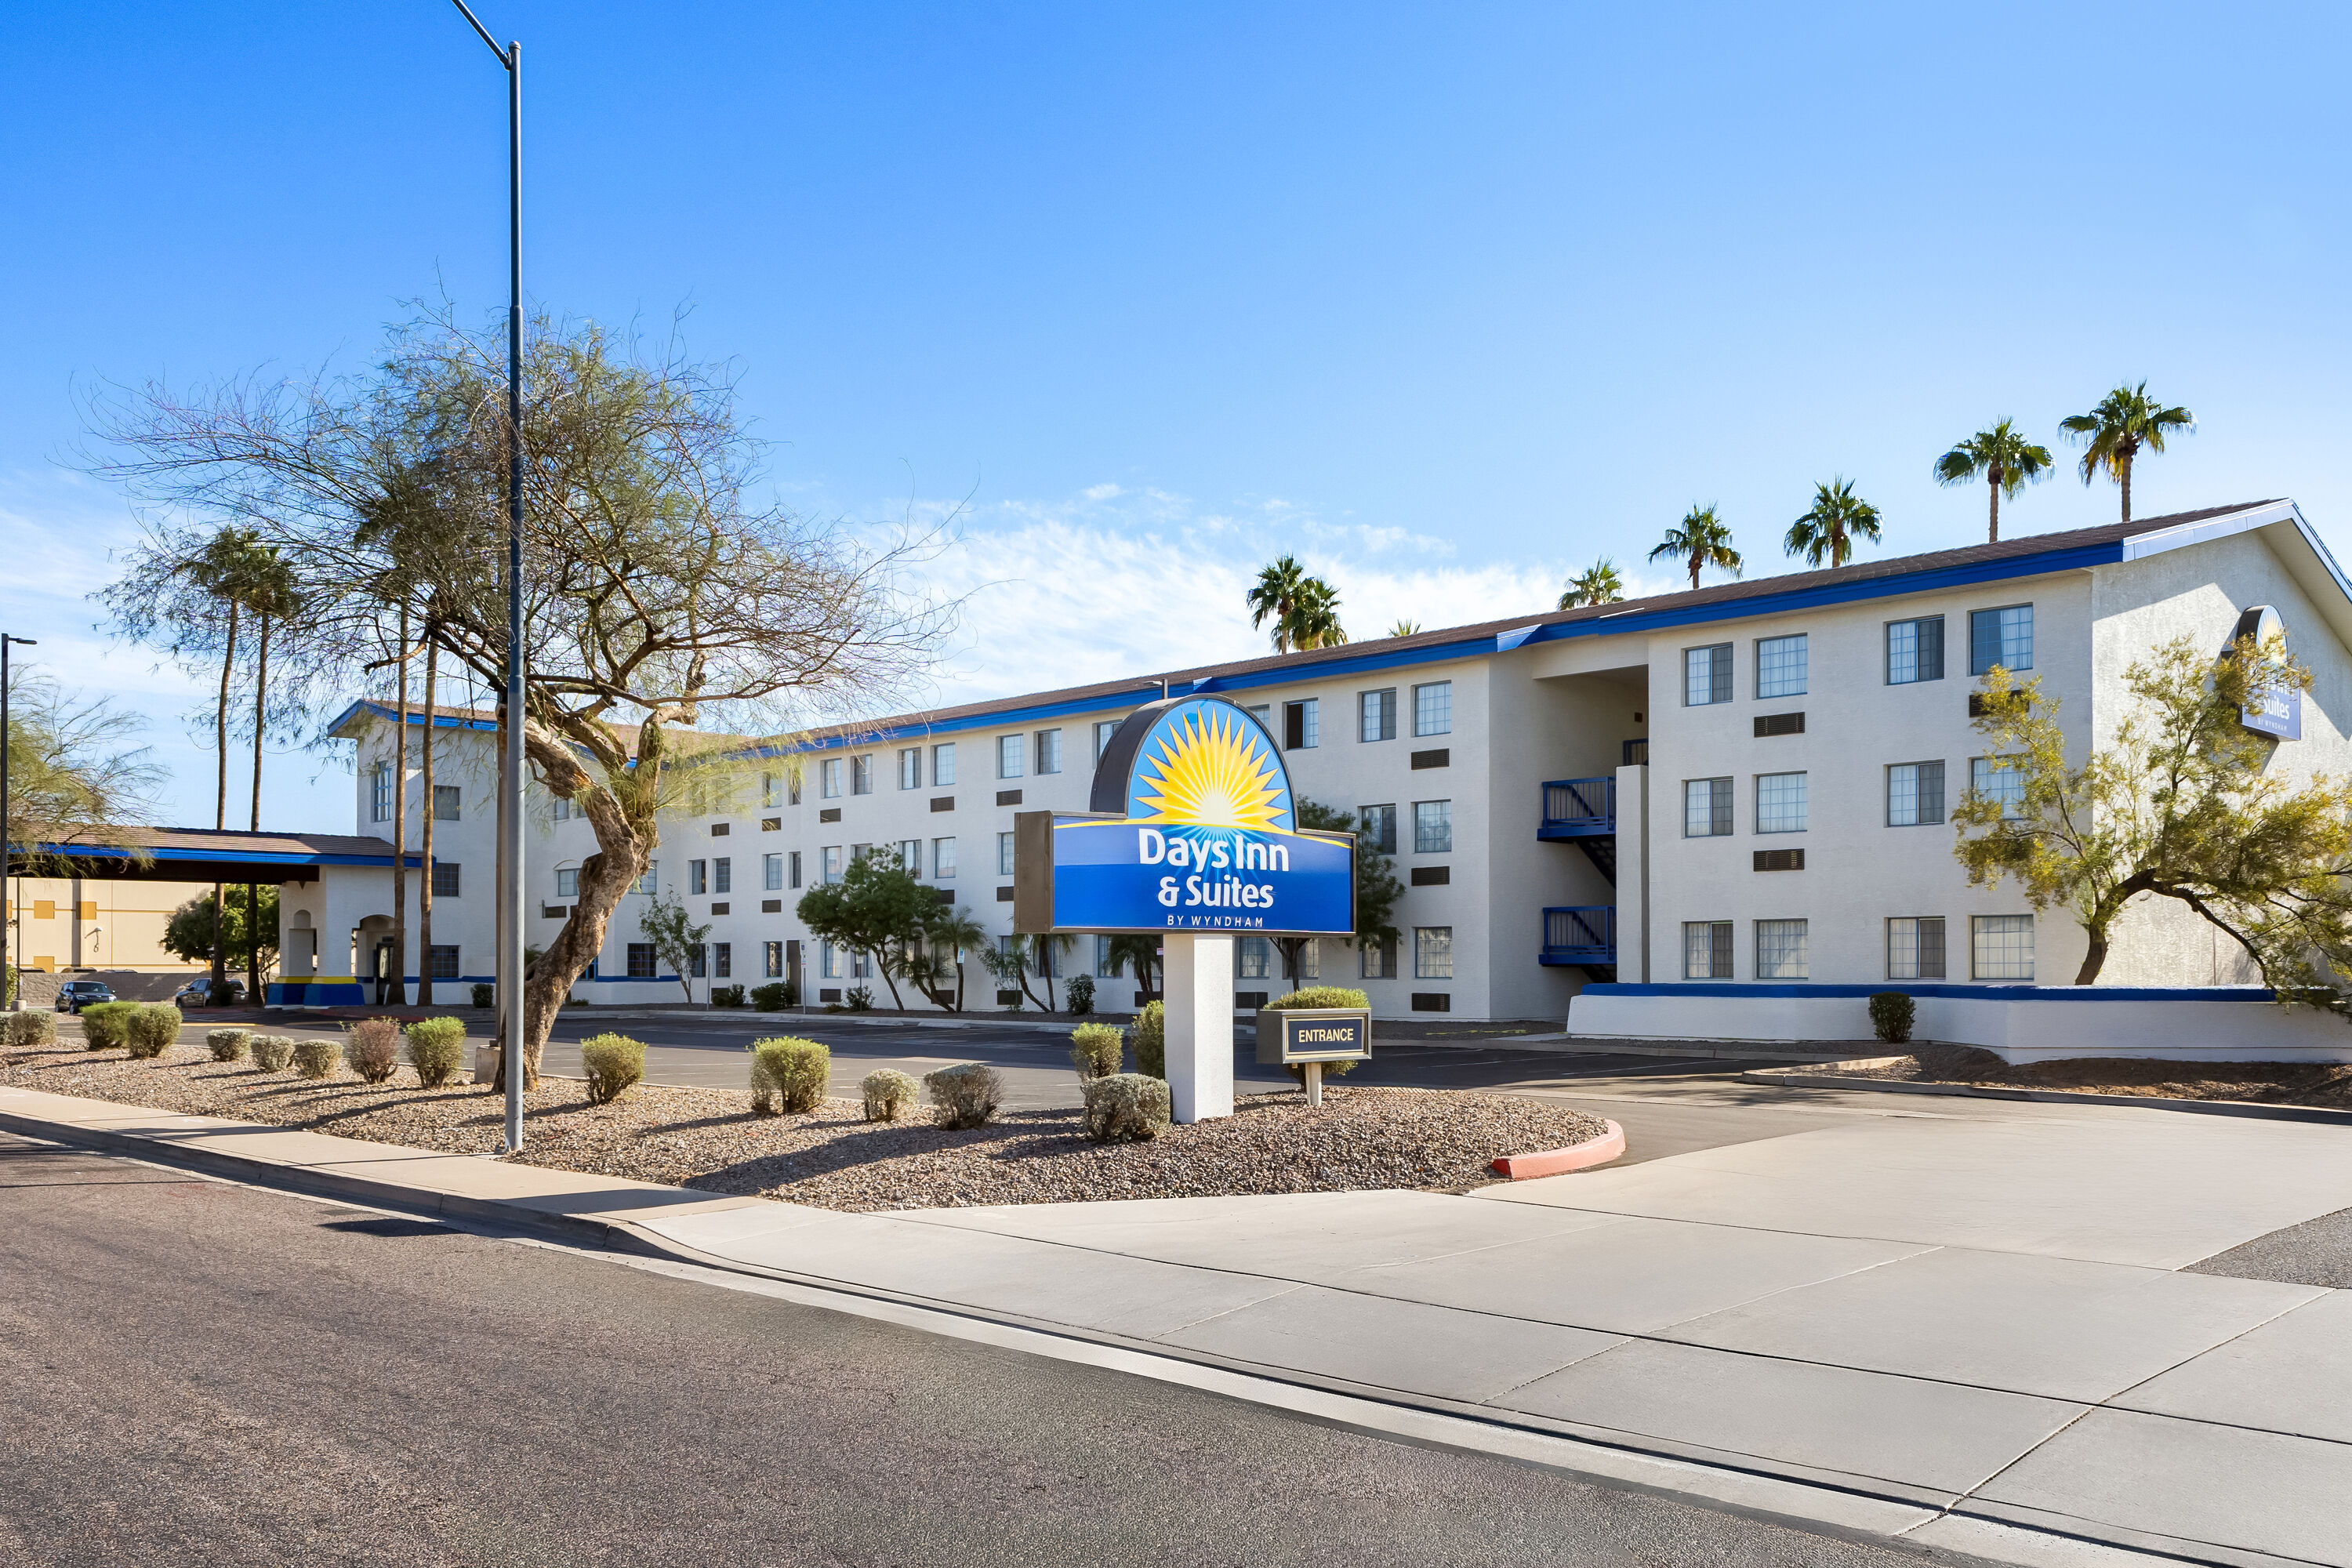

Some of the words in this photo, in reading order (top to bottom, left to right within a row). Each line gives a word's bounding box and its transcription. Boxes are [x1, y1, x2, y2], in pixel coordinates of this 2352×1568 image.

[1138, 828, 1229, 873] Days
[1236, 834, 1290, 872] Inn
[1157, 876, 1180, 907] &
[1185, 874, 1274, 908] Suites
[1167, 914, 1185, 926] BY
[1191, 915, 1264, 927] WYNDHAM
[1298, 1028, 1354, 1043] ENTRANCE
